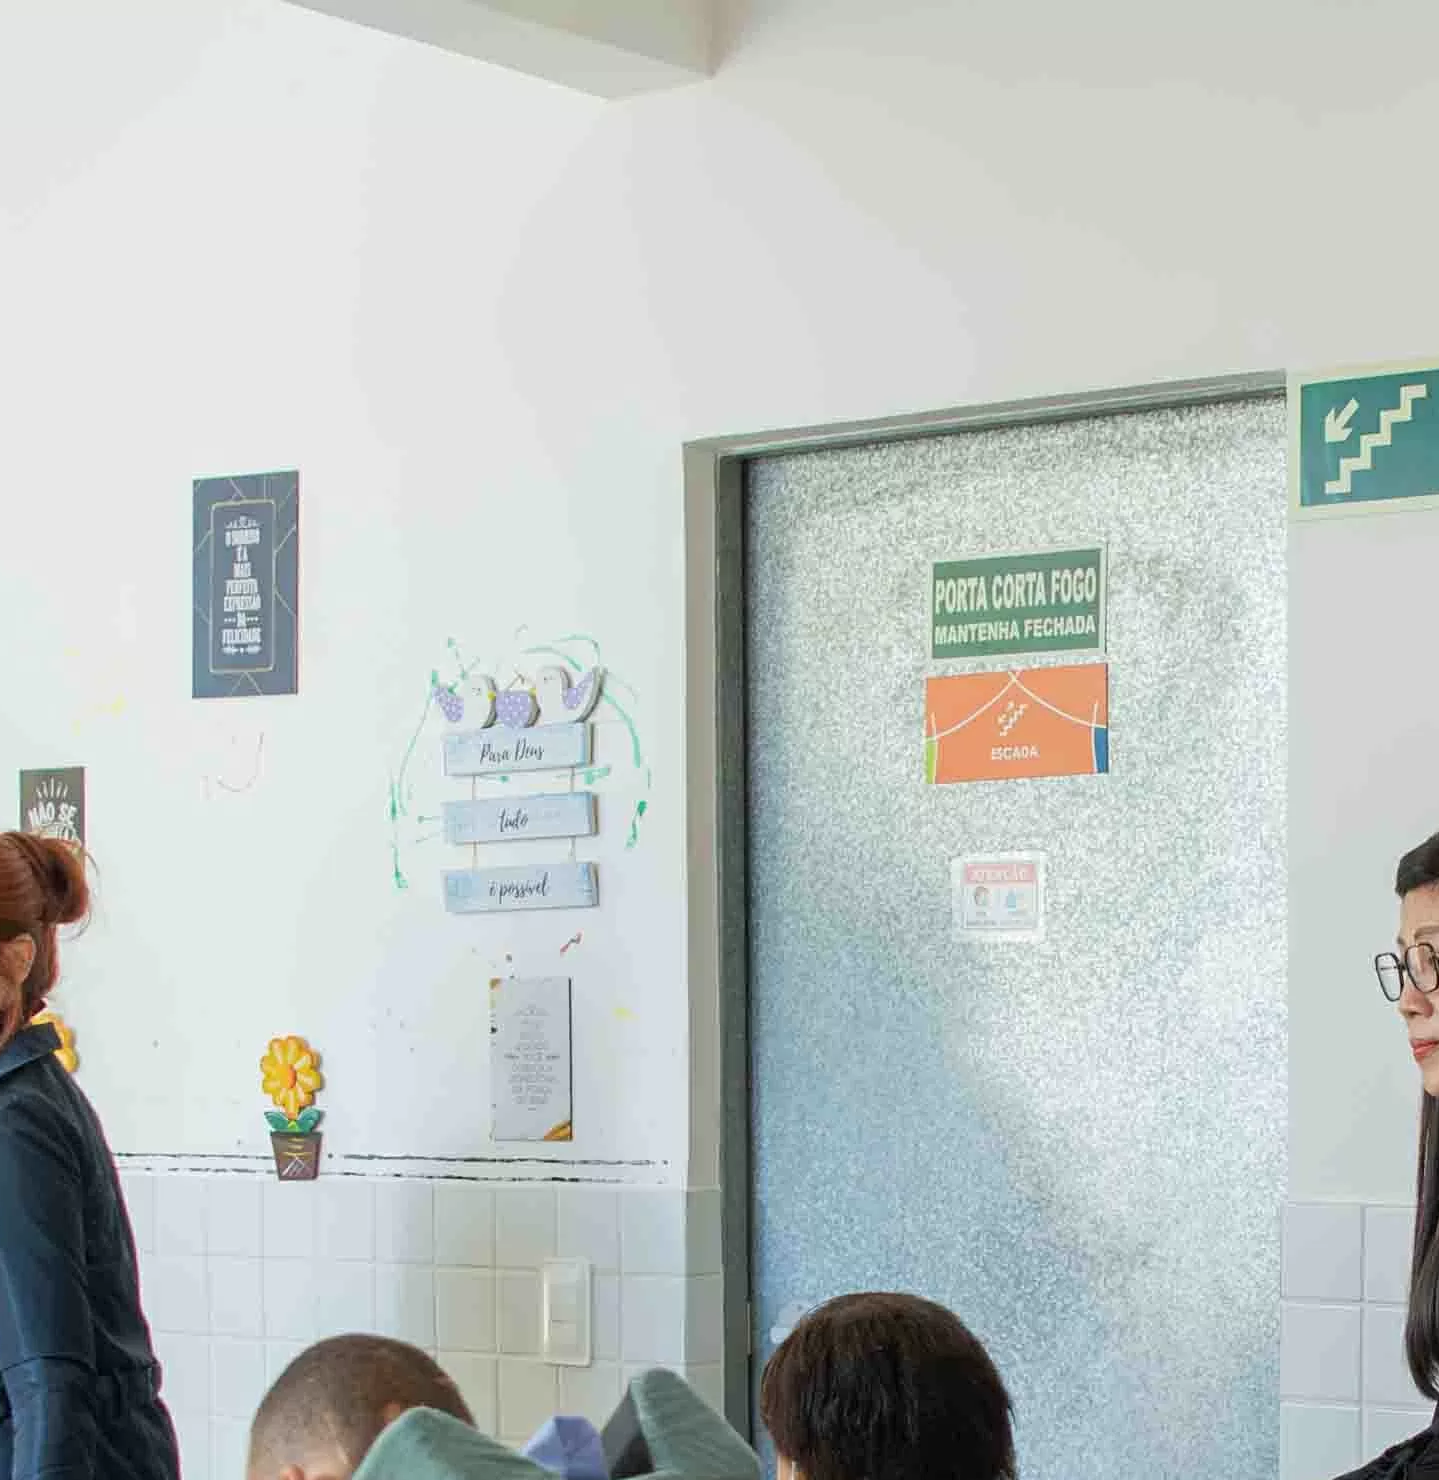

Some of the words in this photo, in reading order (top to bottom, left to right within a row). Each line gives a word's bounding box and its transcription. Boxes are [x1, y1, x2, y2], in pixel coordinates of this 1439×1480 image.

[935, 576, 985, 615] PORTA
[991, 572, 1046, 611] CORTA
[1051, 567, 1097, 604] FOGO
[934, 618, 1019, 646] MANTENHA
[1024, 613, 1096, 638] FECHADA
[990, 745, 1039, 761] ESCADA
